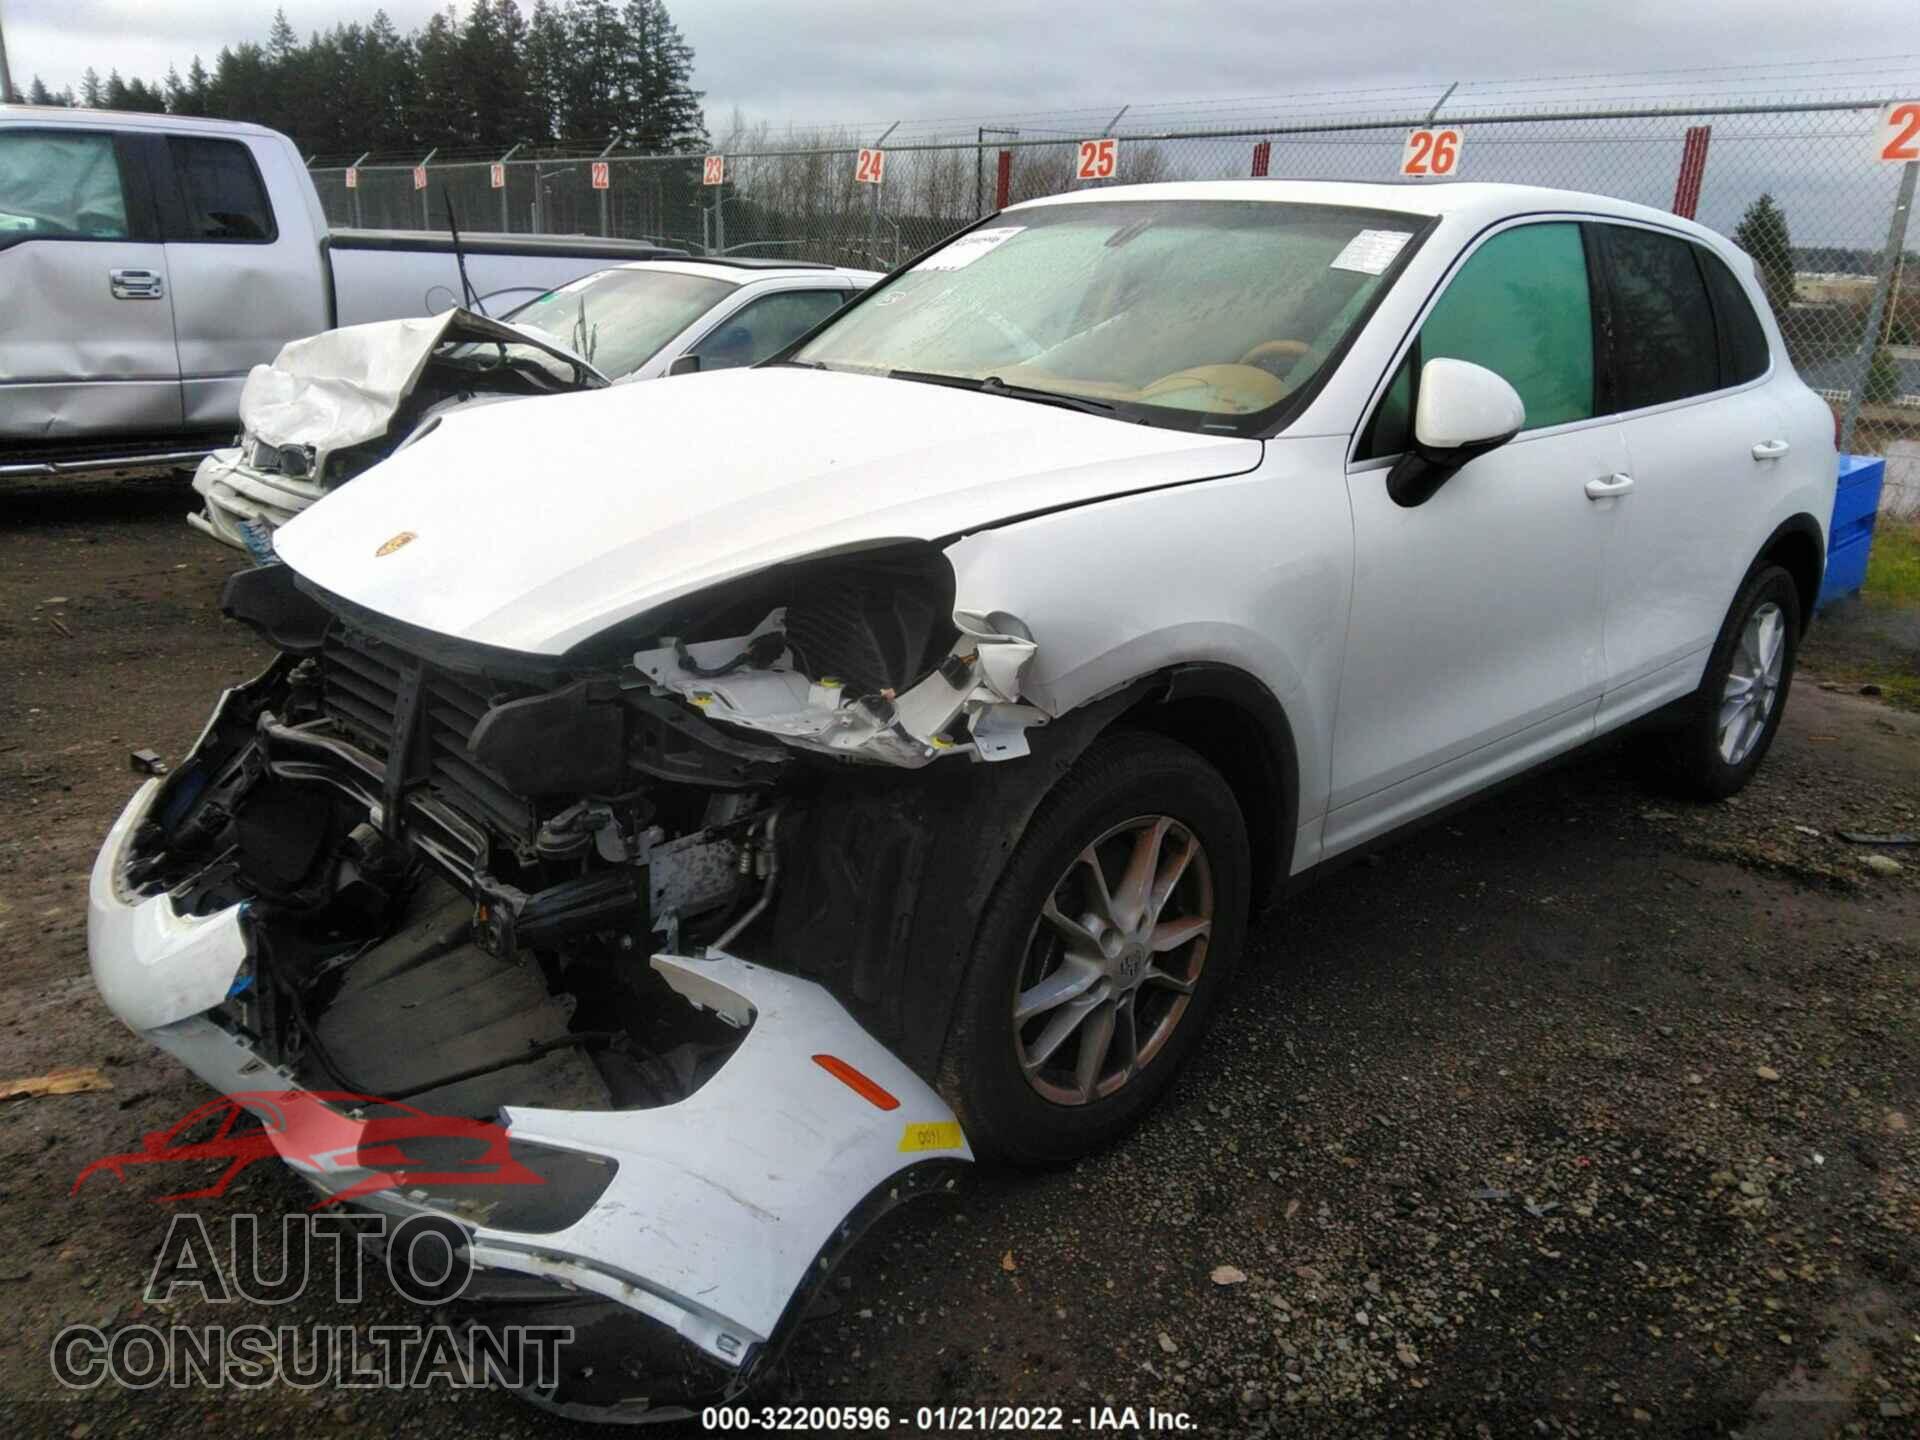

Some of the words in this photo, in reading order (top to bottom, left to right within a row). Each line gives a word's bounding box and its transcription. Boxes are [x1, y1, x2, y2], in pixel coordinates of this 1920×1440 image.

[858, 151, 882, 181] 24
[1080, 141, 1114, 177] 25
[1405, 131, 1457, 173] 26
[593, 164, 609, 187] 22
[705, 158, 722, 183] 23
